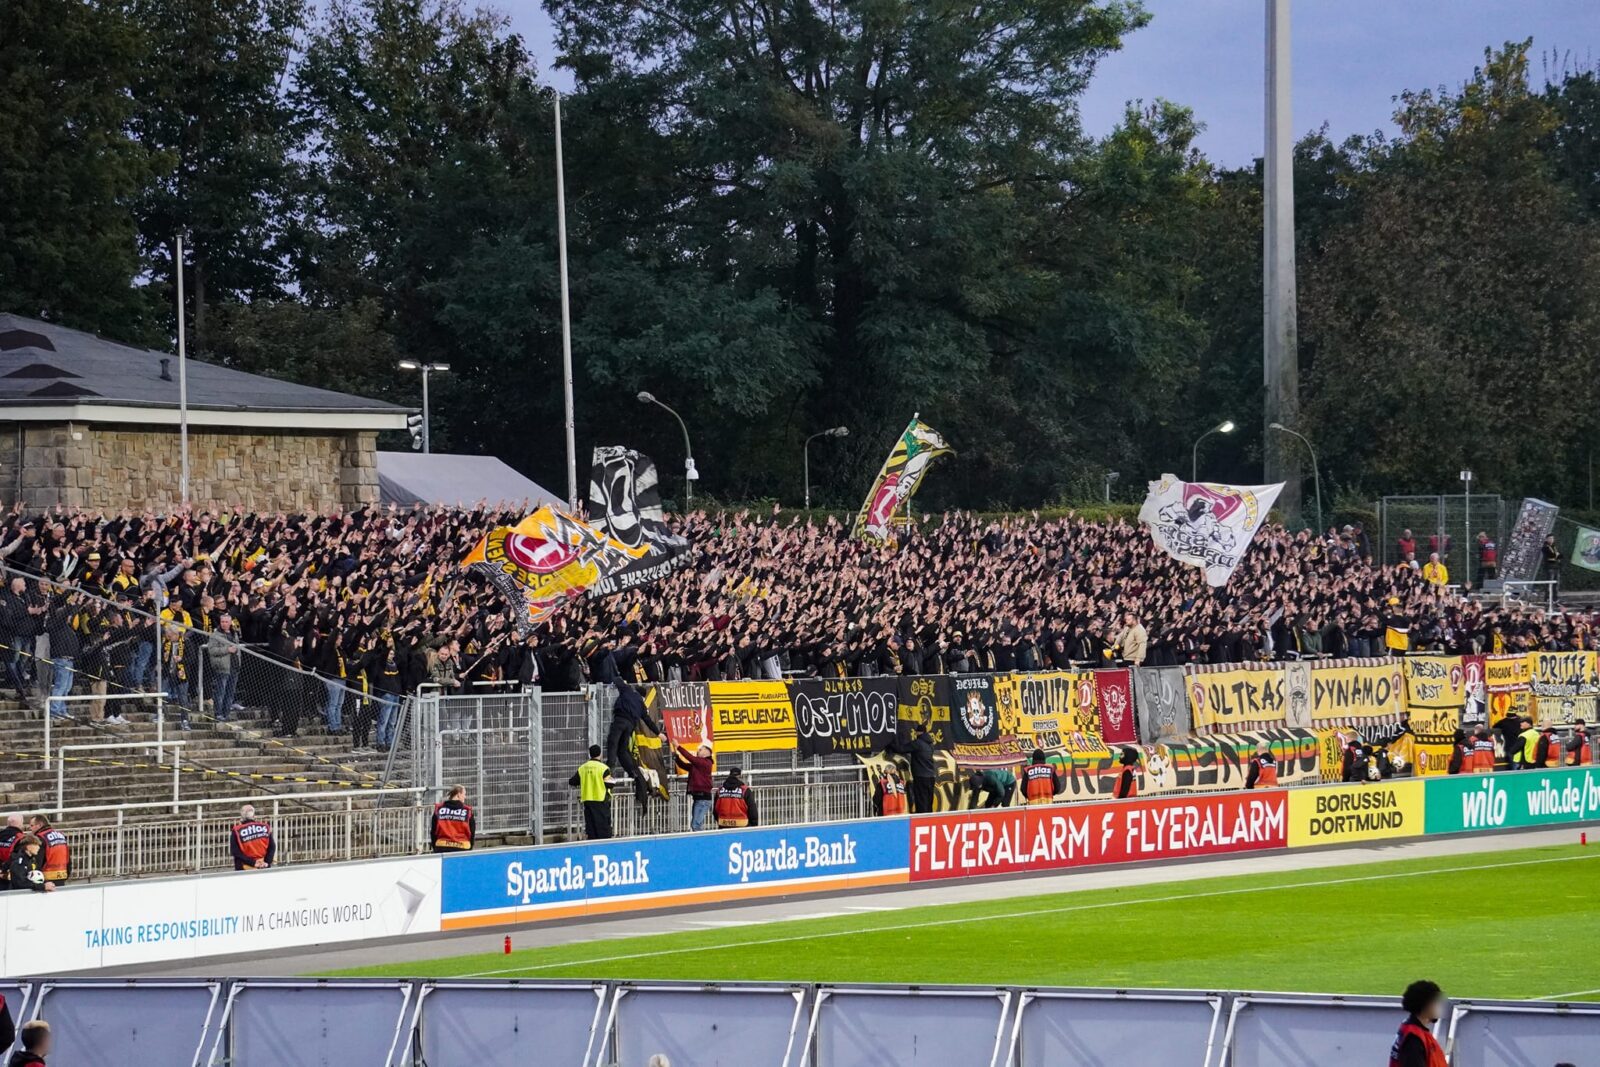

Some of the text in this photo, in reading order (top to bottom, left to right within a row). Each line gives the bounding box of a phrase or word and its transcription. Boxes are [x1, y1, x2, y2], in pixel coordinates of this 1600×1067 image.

[1540, 655, 1587, 680] DRITTE
[660, 686, 705, 708] SCHNELLER
[1208, 678, 1284, 715] ULTRAS
[1314, 674, 1391, 710] DYNAMO
[671, 716, 692, 738] HASE
[1028, 766, 1051, 775] atlas
[439, 807, 468, 816] atlas
[1316, 790, 1397, 814] BORUSSIA
[1462, 777, 1508, 828] wilo
[240, 825, 267, 837] atlas
[915, 799, 1284, 872] FLYERALARM FLYERALARM
[1310, 811, 1403, 836] DORTMUND
[507, 834, 857, 904] Sparda-Bank Sparda-Bank
[85, 903, 373, 948] TAKING RESPONSIBILITY IN A CHANGING WORLD
